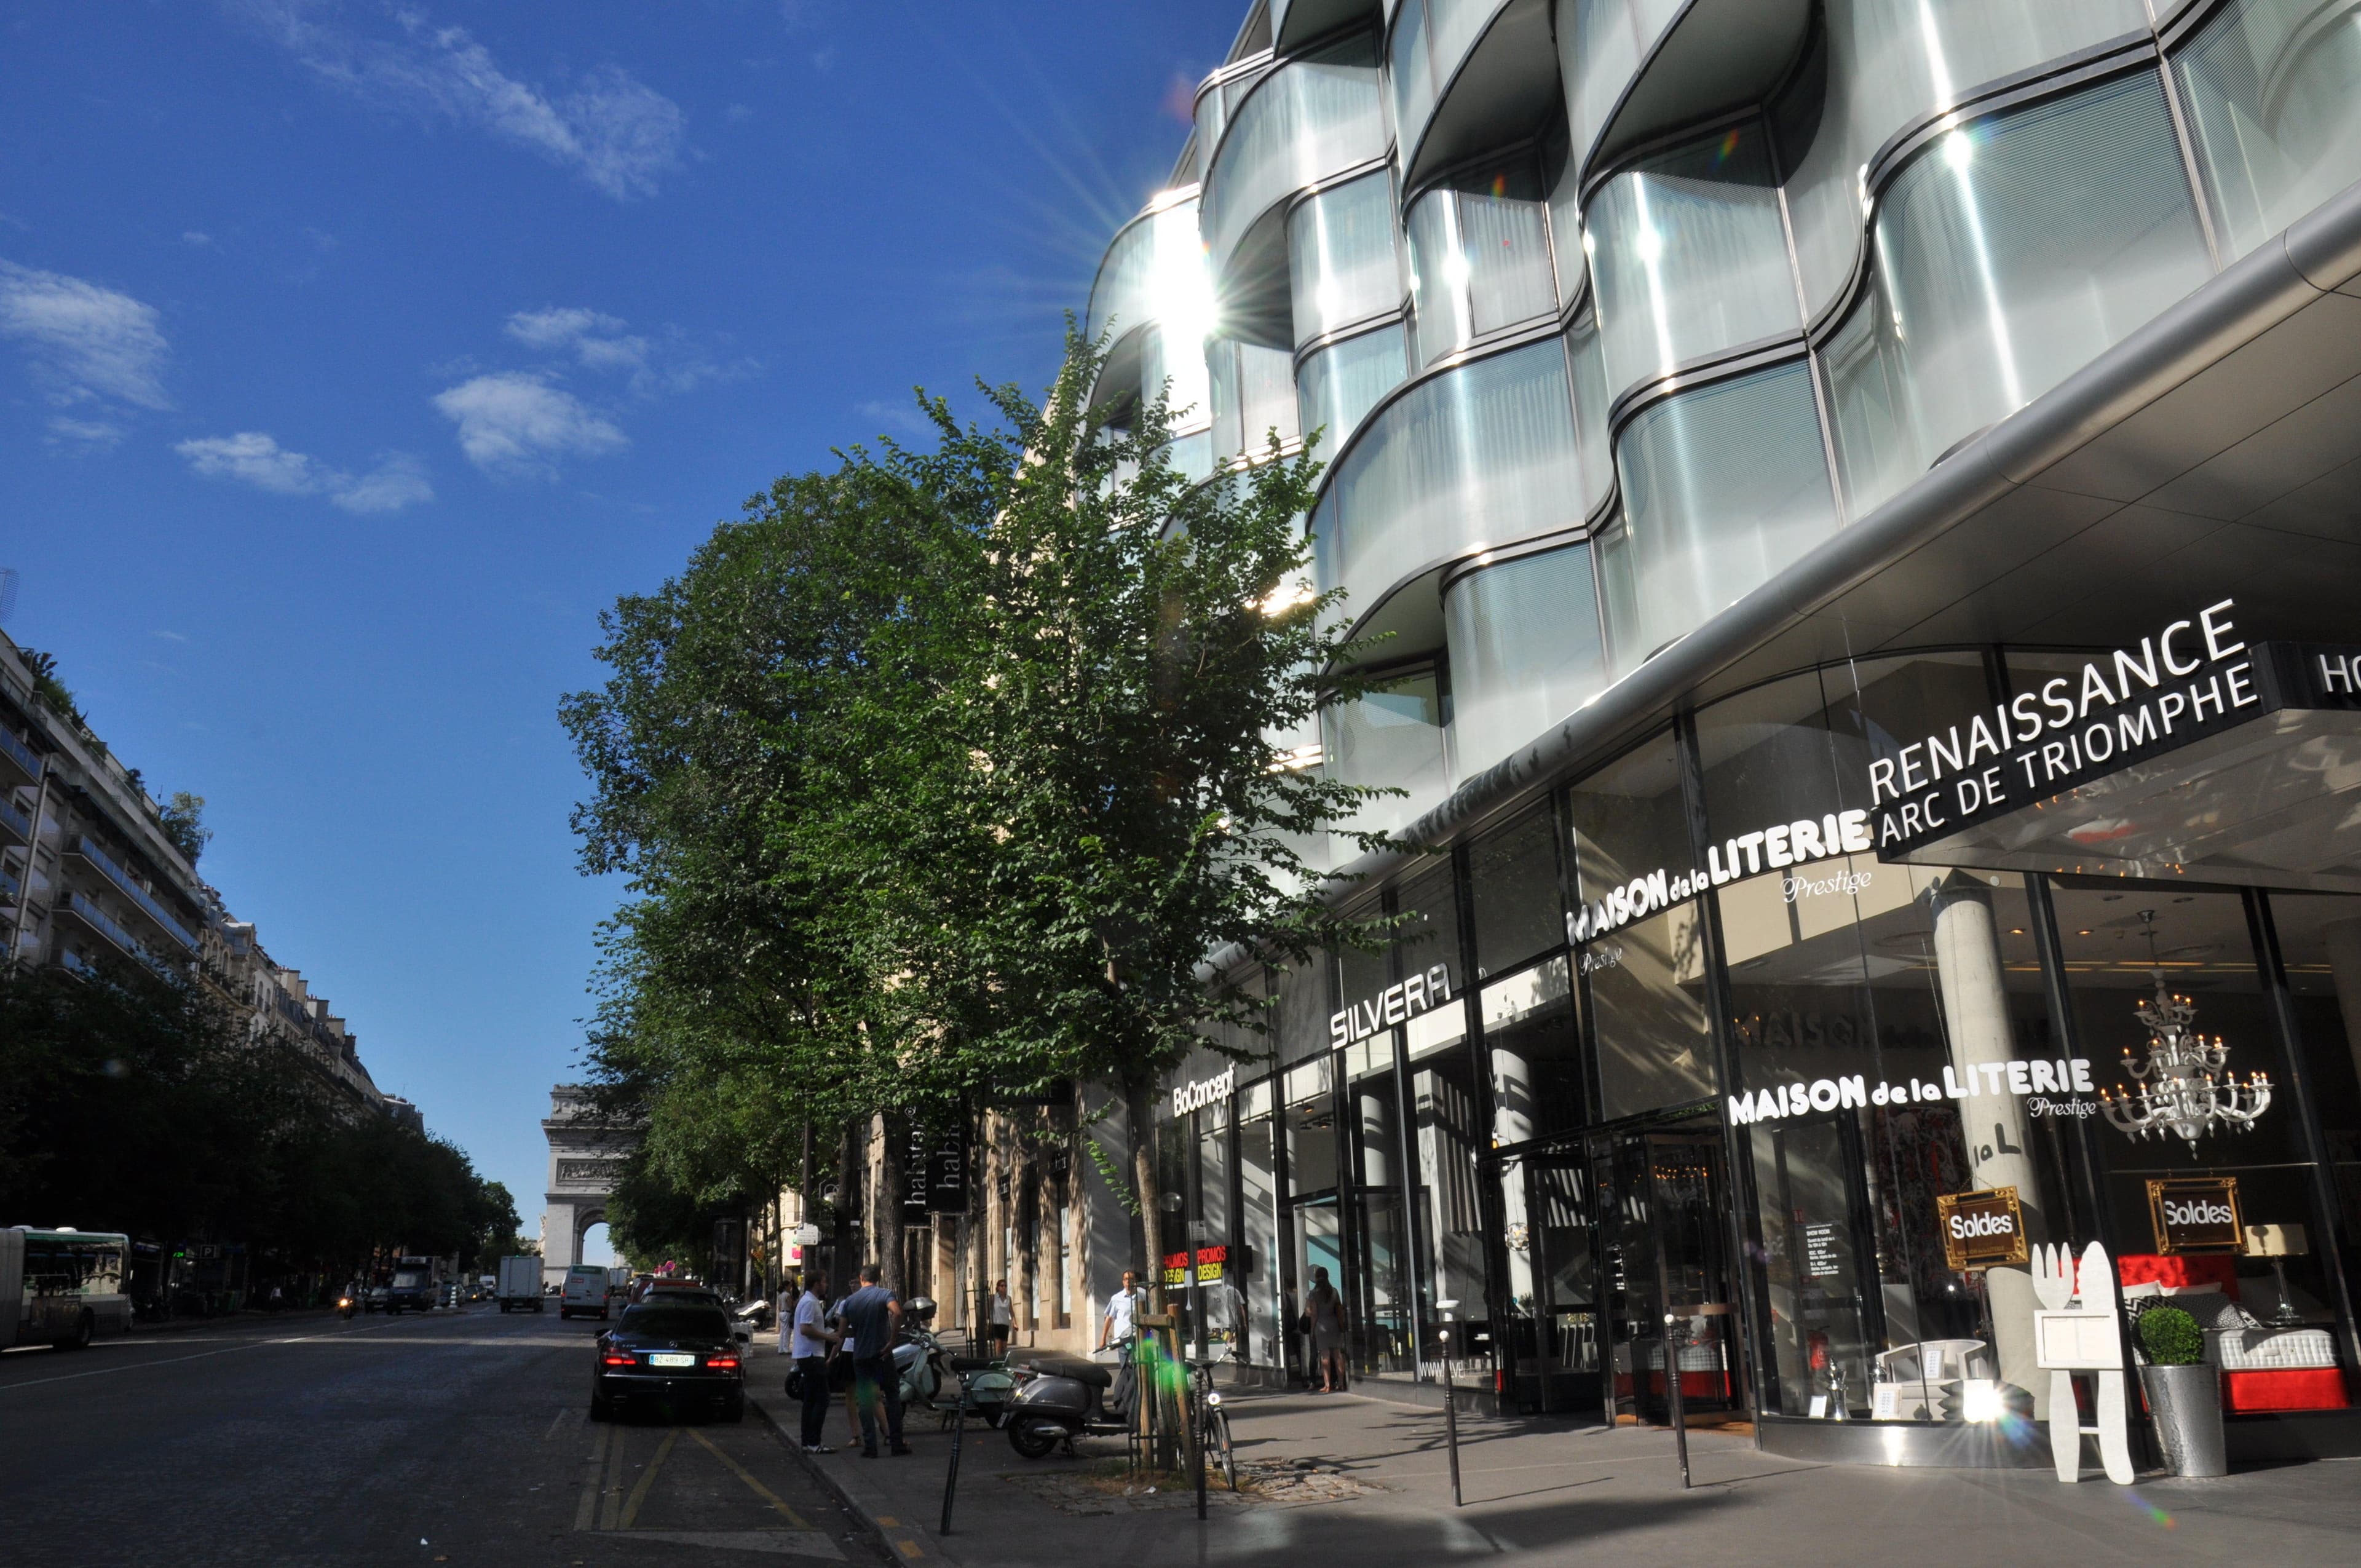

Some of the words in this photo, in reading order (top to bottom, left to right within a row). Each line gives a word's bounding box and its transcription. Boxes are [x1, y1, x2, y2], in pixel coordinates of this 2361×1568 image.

[1869, 598, 2245, 804] RENAISSANCE
[1881, 791, 1945, 847] ARC
[1957, 766, 2006, 815] DE
[2017, 662, 2259, 788] TRIOMPHE
[1567, 869, 1667, 946] MAISON
[1708, 809, 1870, 885] LITERIE
[1780, 870, 1872, 903] Prestige
[1330, 963, 1450, 1050] SILVERA
[1728, 1074, 1867, 1127] MAISON
[1872, 1081, 1908, 1106] de
[1911, 1079, 1942, 1102] la
[1943, 1058, 2095, 1099] LITERIE
[2027, 1097, 2097, 1119] Prestige
[1950, 1211, 2012, 1239] Soldes
[2164, 1200, 2232, 1225] Soldes
[1197, 1245, 1227, 1265] PROMOS
[1198, 1262, 1222, 1281] DESIGN
